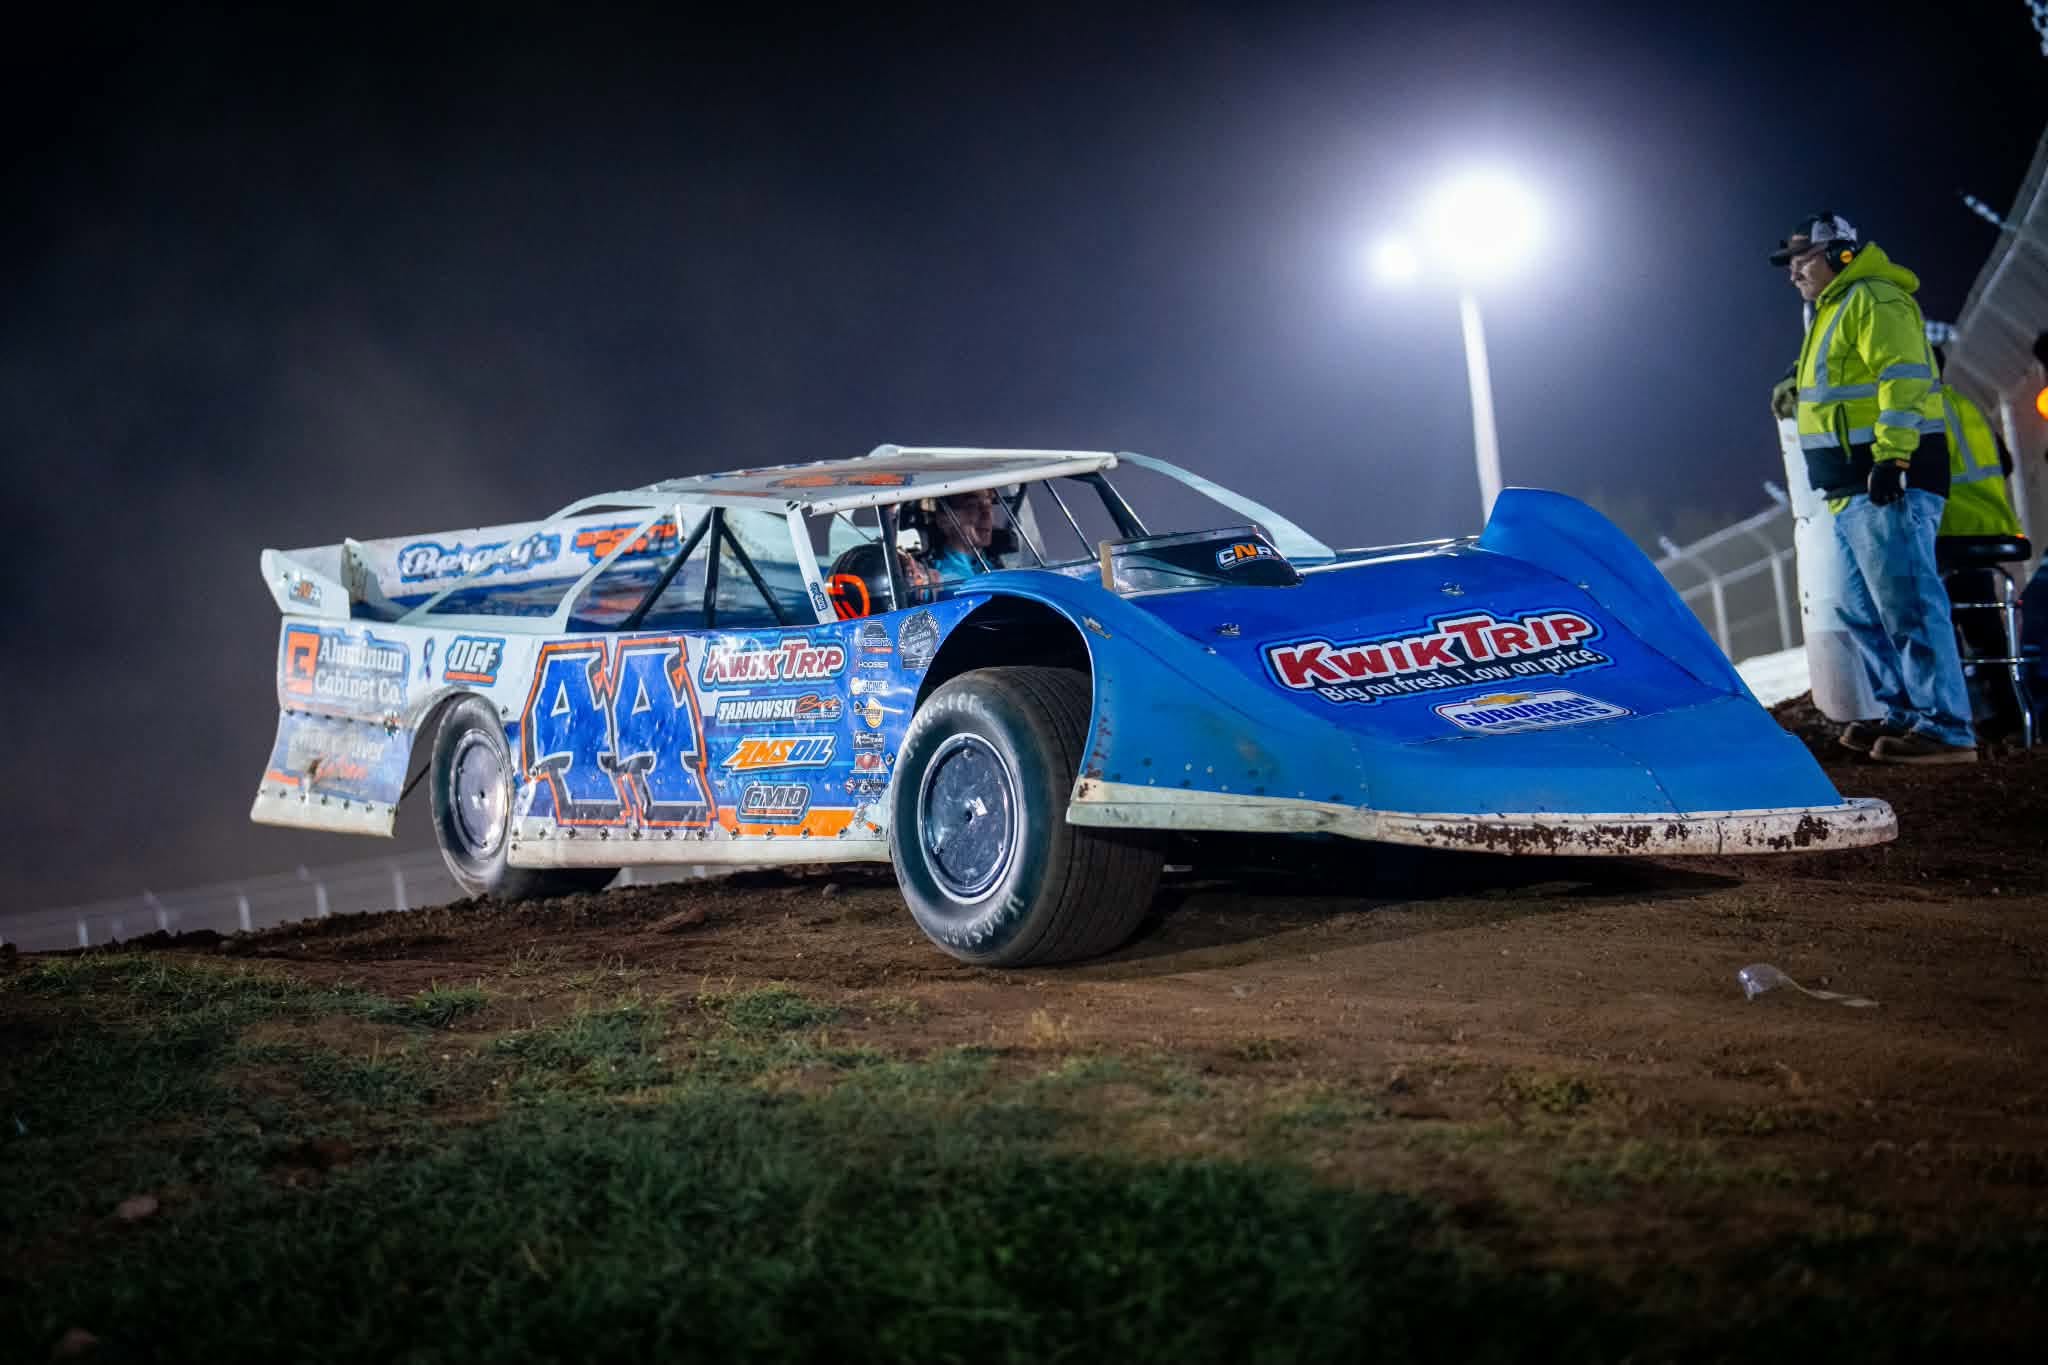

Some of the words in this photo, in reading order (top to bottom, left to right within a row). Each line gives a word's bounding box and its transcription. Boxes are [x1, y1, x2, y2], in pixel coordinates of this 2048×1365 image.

[318, 635, 404, 673] Aluminum
[314, 668, 378, 699] Cabinet
[1318, 685, 1371, 702] Big
[1365, 681, 1397, 696] on
[1393, 669, 1466, 692] fresh.
[1458, 663, 1511, 683] Low
[1510, 660, 1541, 675] on
[1538, 648, 1605, 674] price.
[718, 699, 797, 721] TARNOWSKI
[1454, 696, 1597, 727] SUBURBAN
[724, 738, 834, 770] AMSOIL
